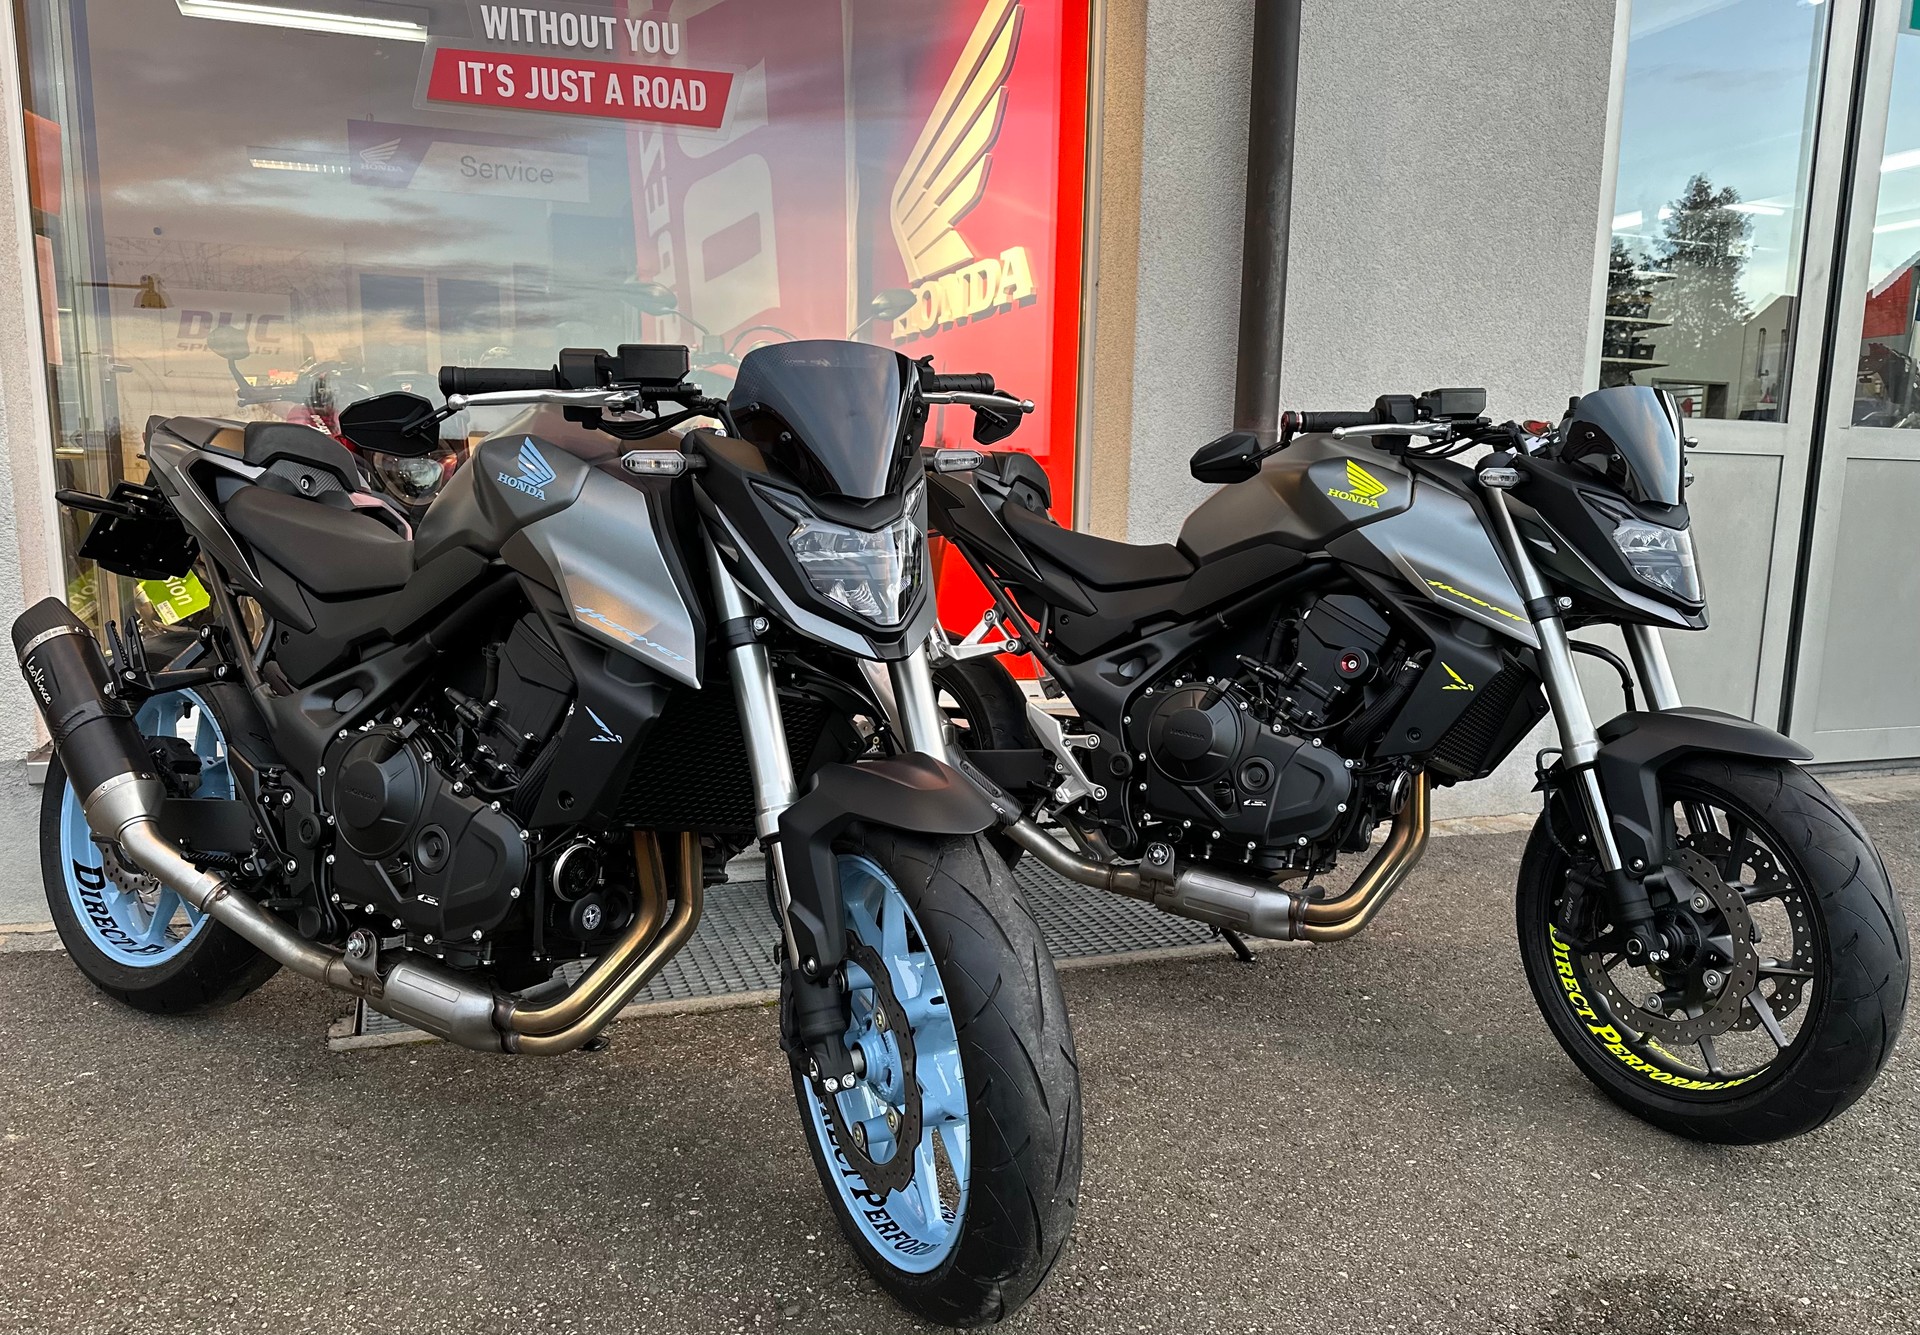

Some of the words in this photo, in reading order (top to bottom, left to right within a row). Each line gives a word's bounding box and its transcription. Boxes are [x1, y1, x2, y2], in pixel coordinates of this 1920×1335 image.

[480, 4, 617, 50] WITHOUT
[624, 19, 680, 55] YOU
[458, 60, 515, 98] IT'S
[524, 66, 596, 103] JUST
[604, 73, 625, 106] A
[633, 75, 707, 112] ROAD
[460, 155, 555, 184] Service
[497, 472, 546, 501] HONDA
[1327, 488, 1379, 509] HONDA
[72, 858, 138, 947] DIRECT
[1586, 1023, 1772, 1091] PERFORMA
